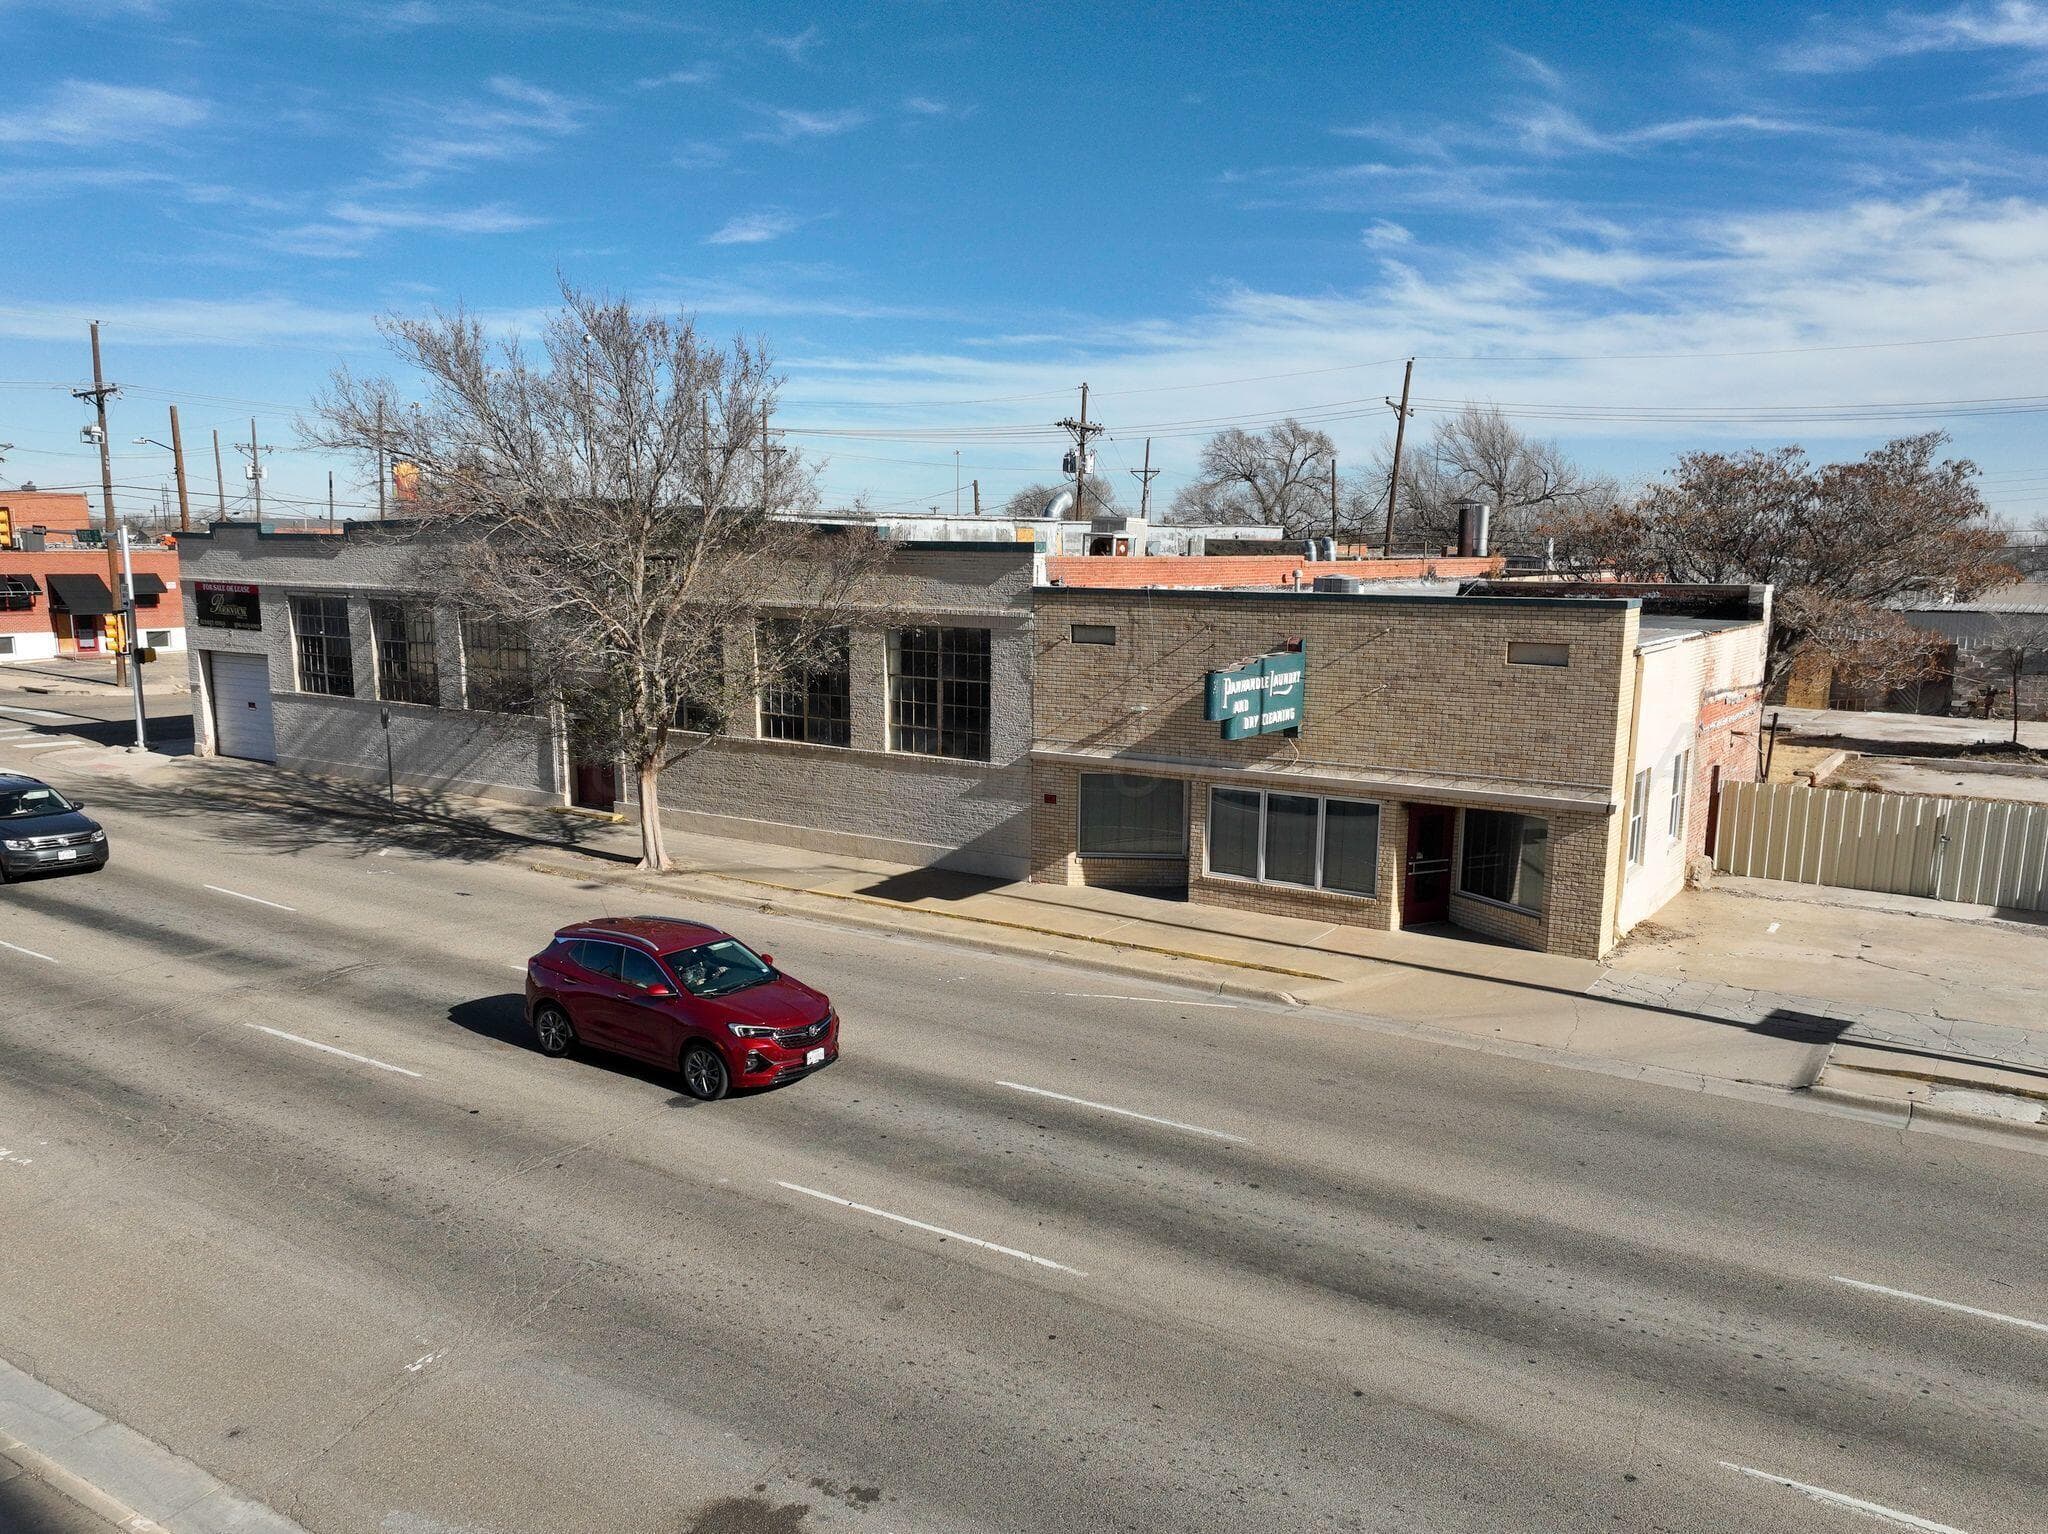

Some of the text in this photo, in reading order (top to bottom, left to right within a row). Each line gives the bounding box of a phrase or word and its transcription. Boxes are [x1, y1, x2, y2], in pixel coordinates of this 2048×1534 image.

[212, 584, 226, 592] SALE
[1223, 670, 1301, 709] PANHANDLE LAUNDRY
[1233, 699, 1249, 714] AND
[1243, 708, 1296, 730] DRY CLEANING
